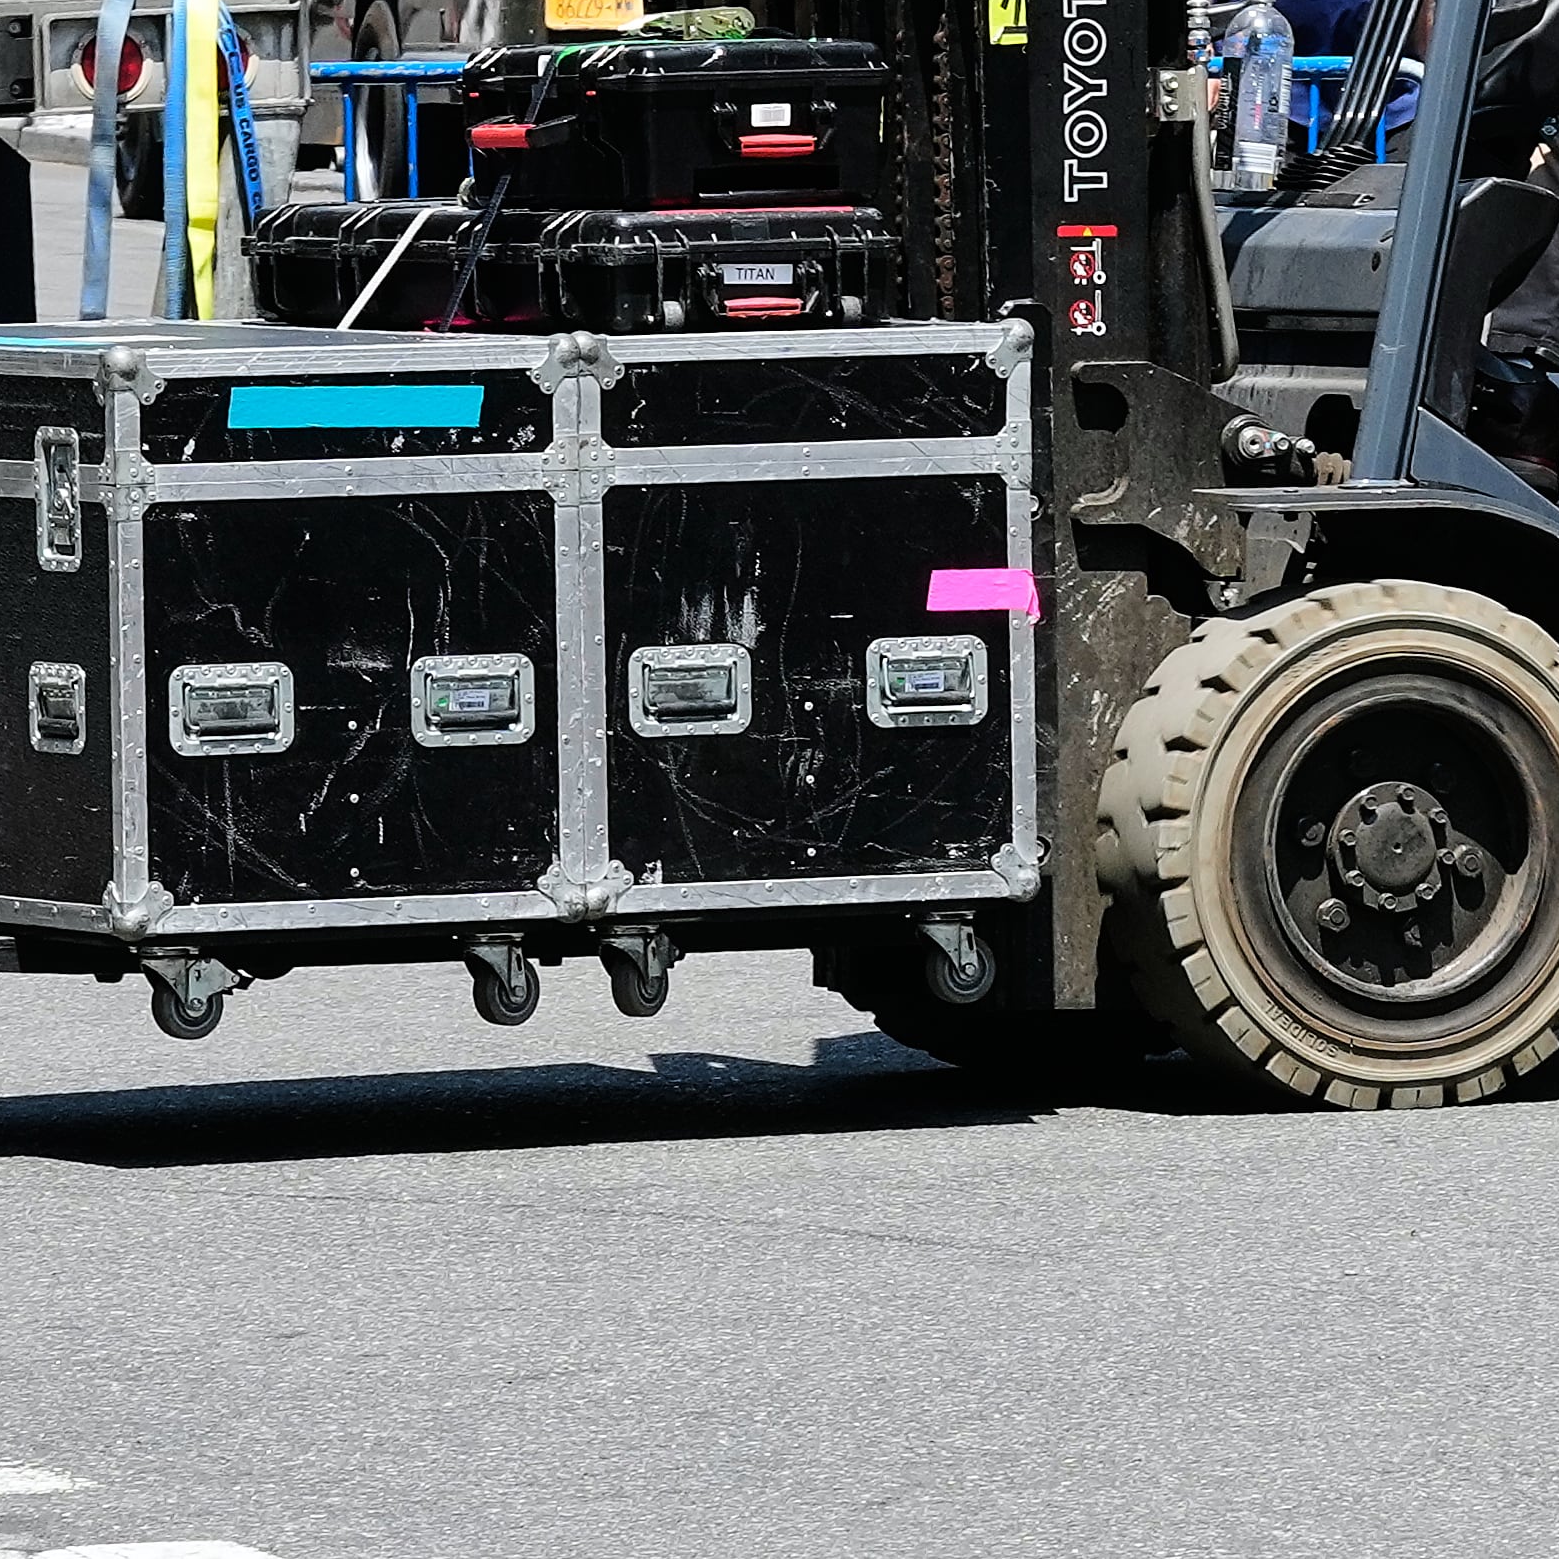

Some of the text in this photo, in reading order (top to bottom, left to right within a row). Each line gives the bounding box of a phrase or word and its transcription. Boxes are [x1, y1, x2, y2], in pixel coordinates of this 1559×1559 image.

[239, 118, 261, 183] CARGO
[734, 267, 776, 282] TITAN
[1265, 997, 1340, 1059] SOLIDEAL
